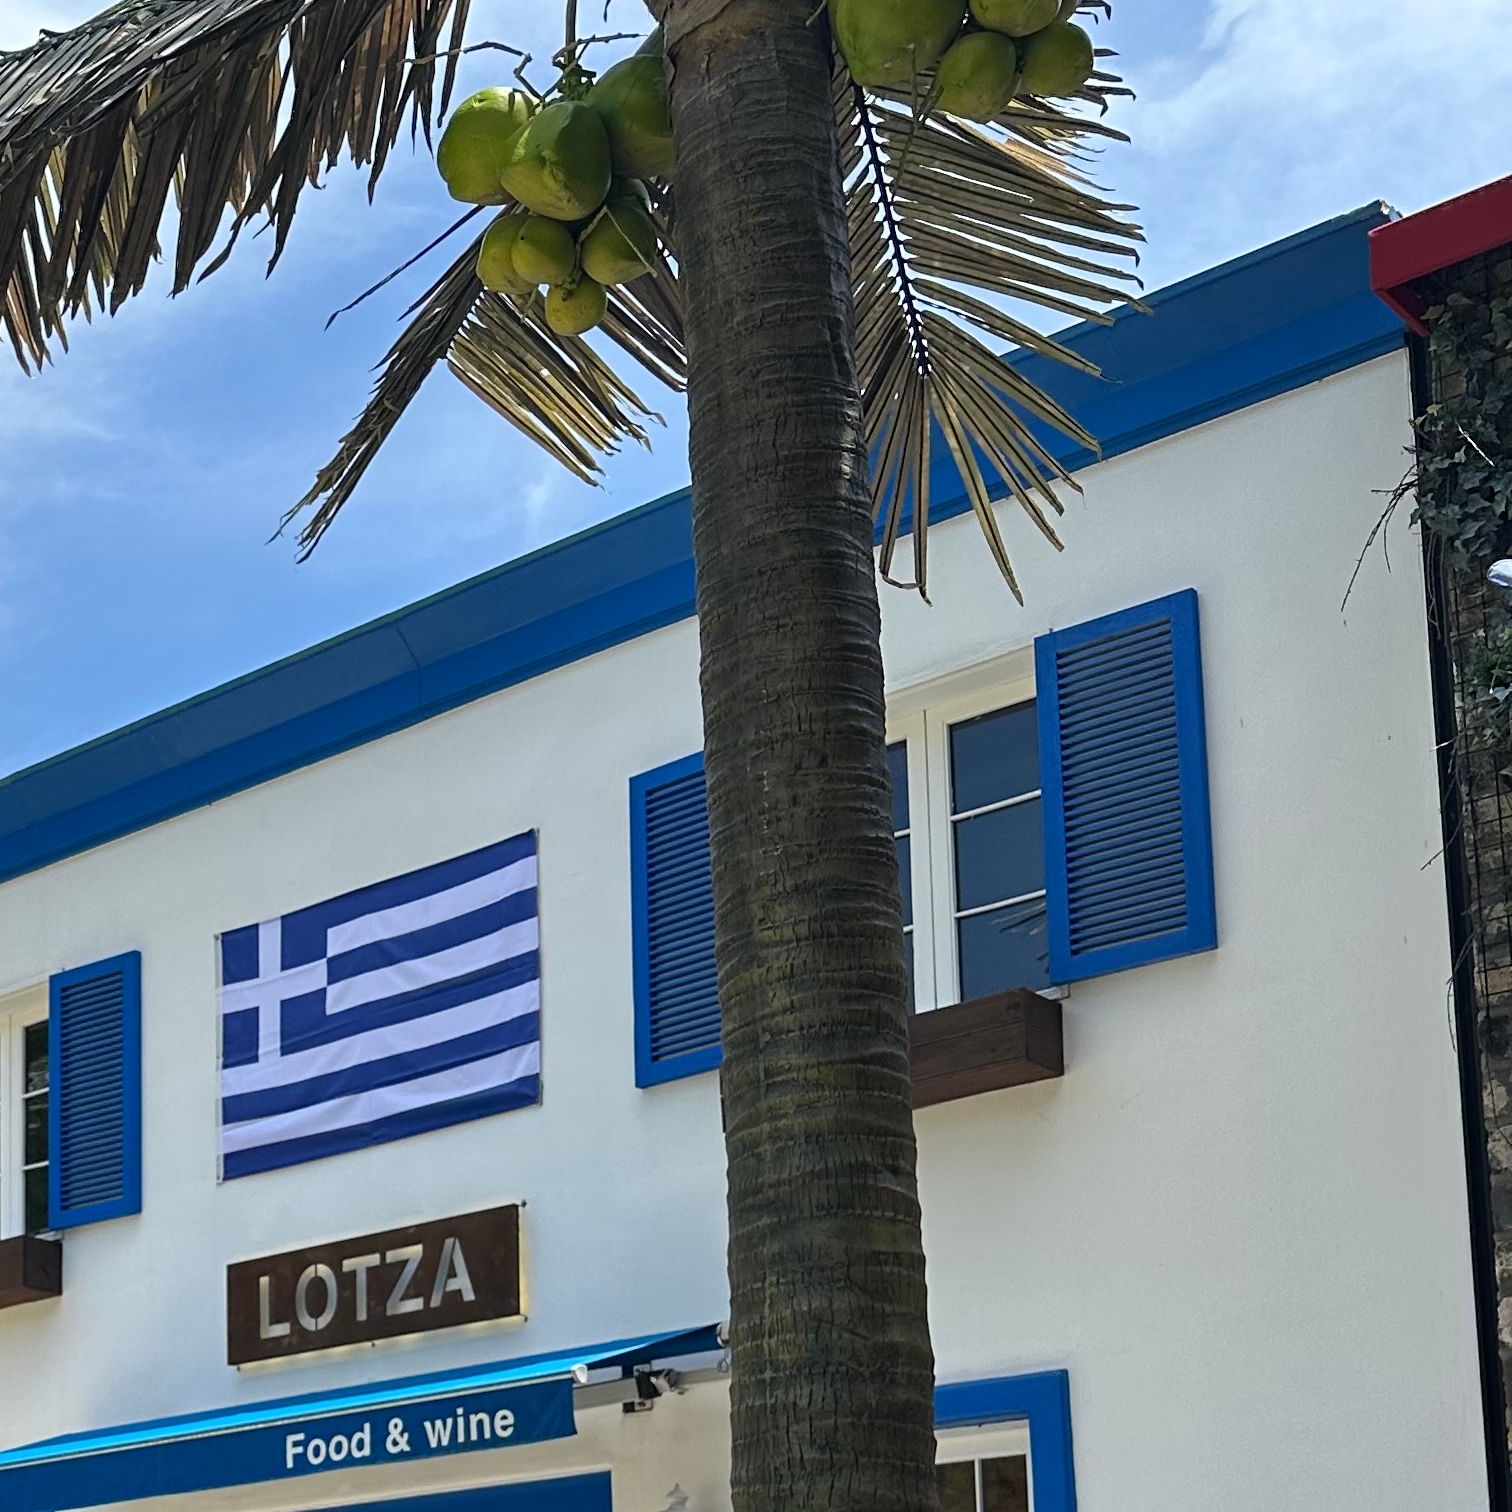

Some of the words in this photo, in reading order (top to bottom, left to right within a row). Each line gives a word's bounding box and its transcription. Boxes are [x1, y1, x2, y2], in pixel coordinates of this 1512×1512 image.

[259, 1236, 476, 1340] LOTZA
[285, 1421, 371, 1469] Food
[385, 1417, 411, 1454] &
[424, 1407, 515, 1449] wine
